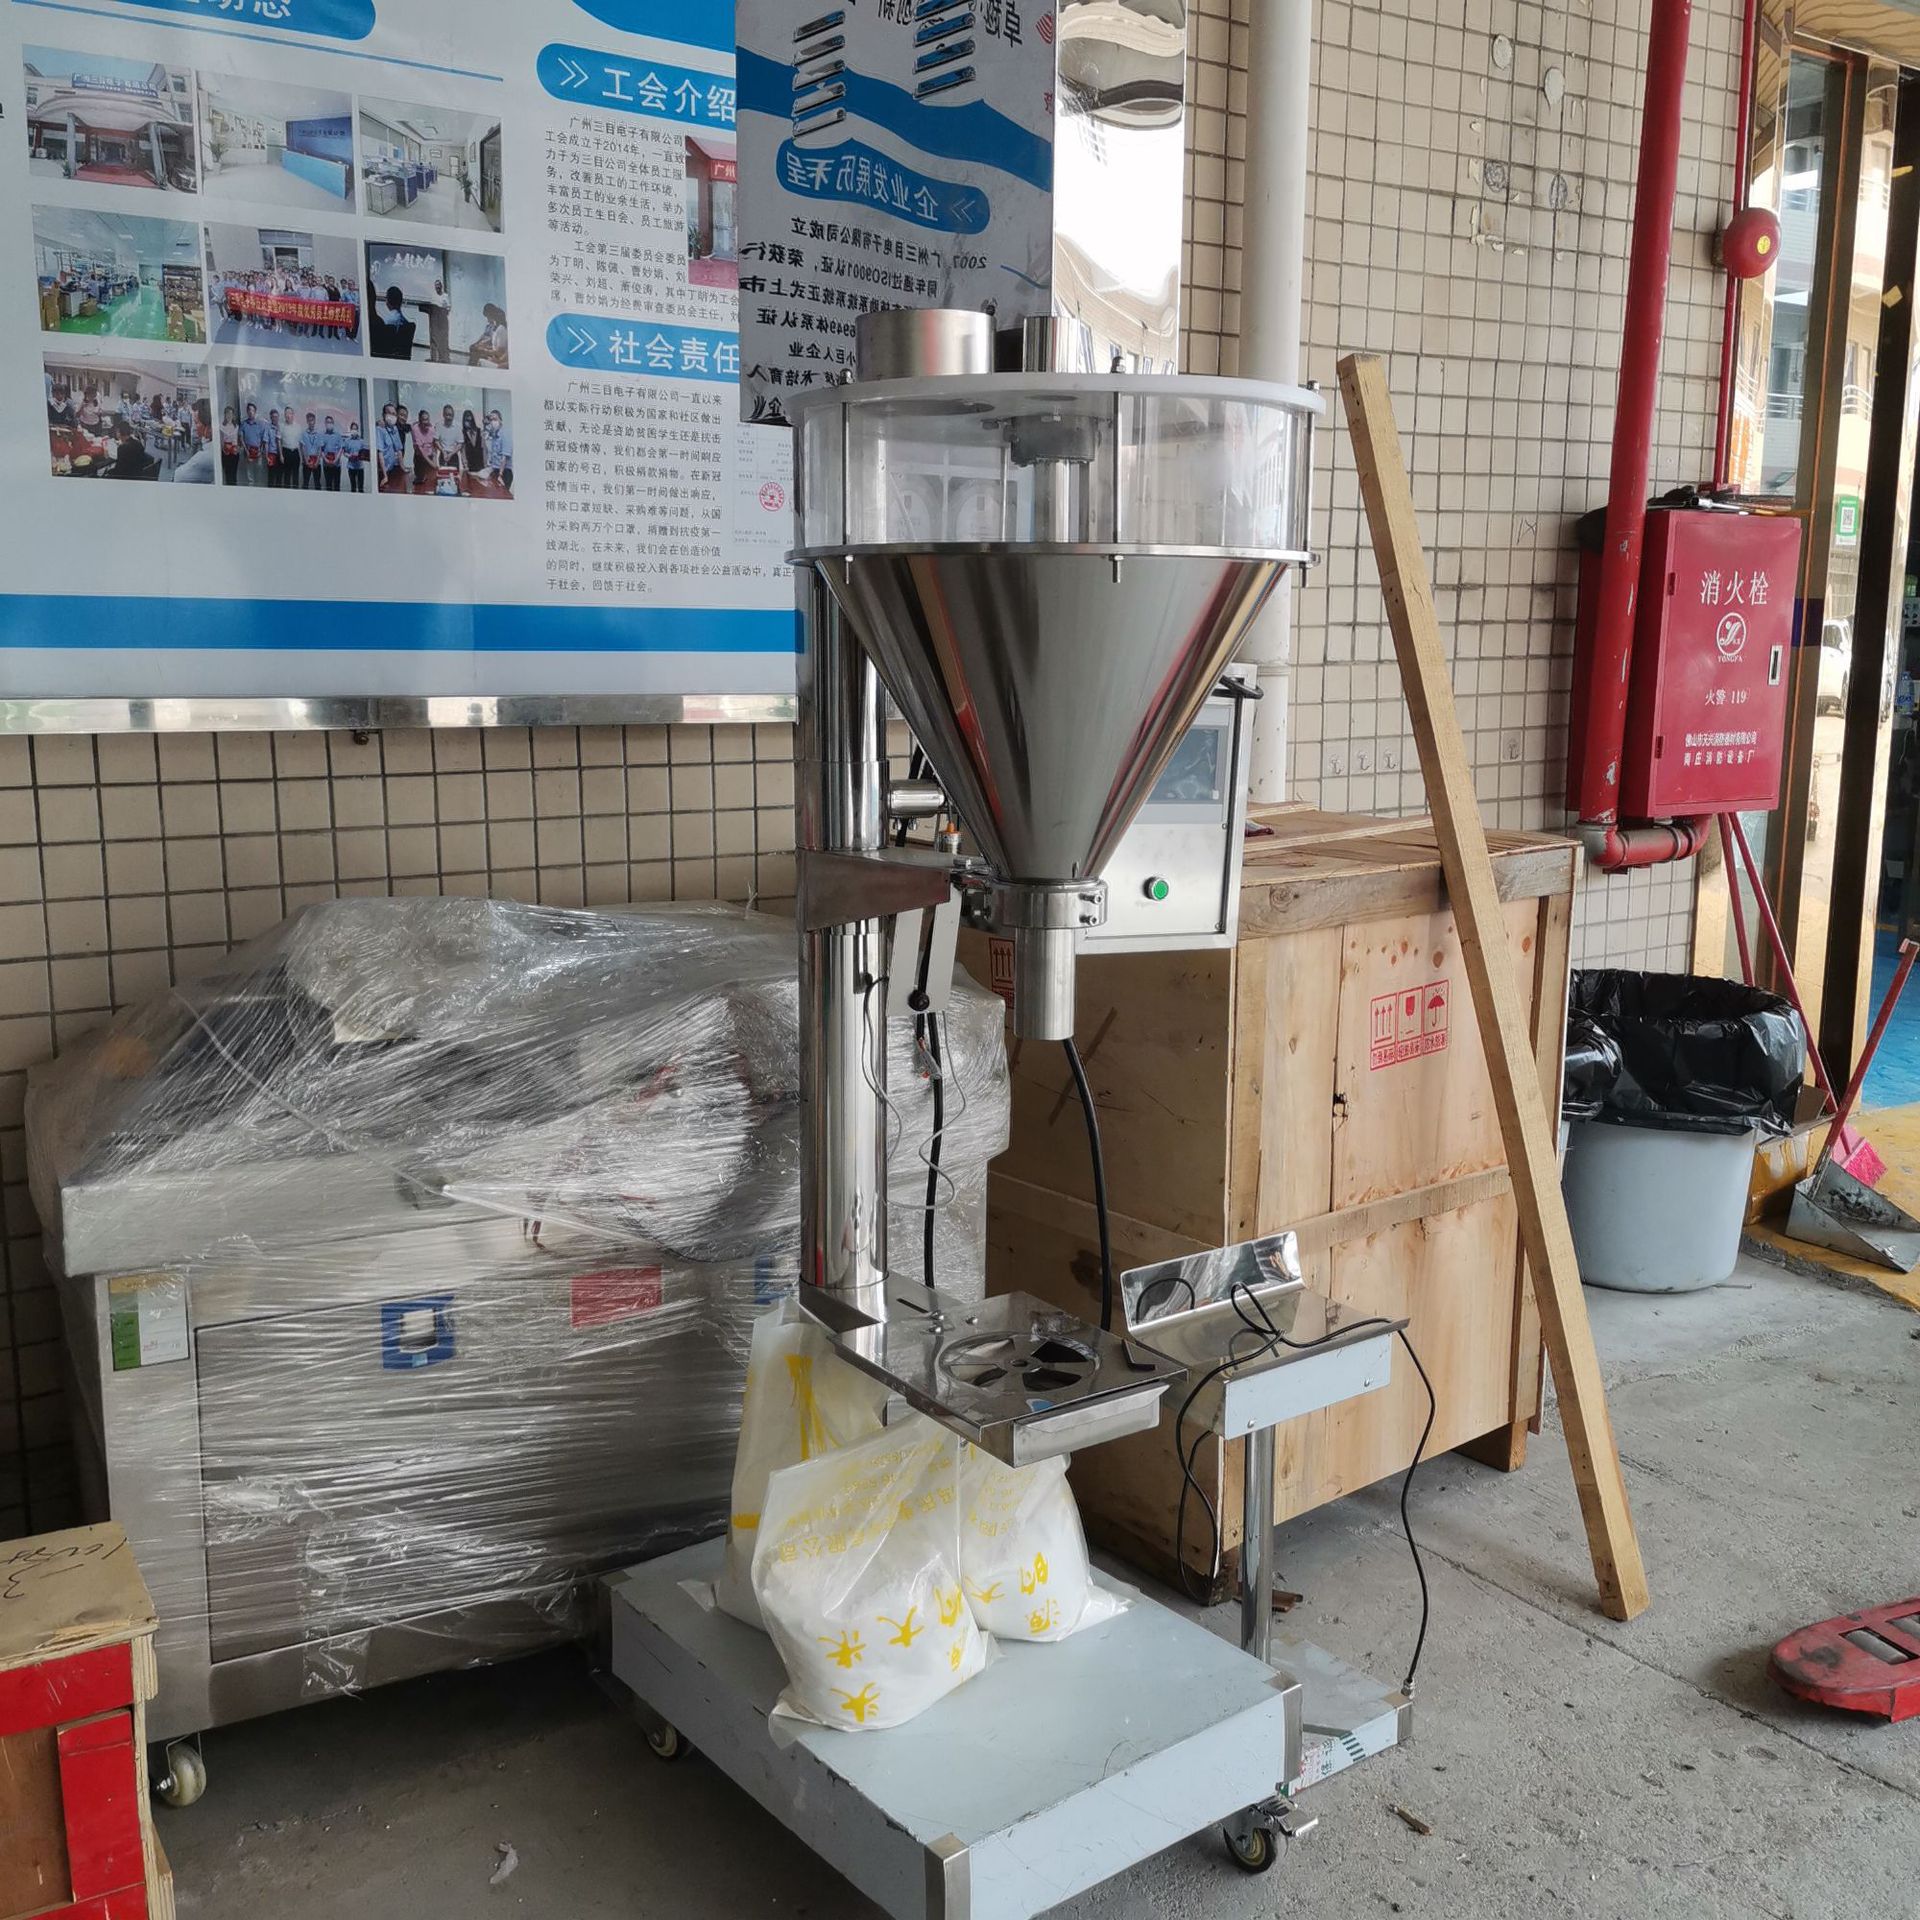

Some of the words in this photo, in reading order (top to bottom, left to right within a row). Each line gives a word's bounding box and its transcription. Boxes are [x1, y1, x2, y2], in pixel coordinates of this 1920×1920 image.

[602, 67, 736, 122] 工会介绍
[570, 117, 683, 147] 广州三目电子有限公司
[609, 330, 740, 374] 社会责任
[568, 381, 722, 405] 广州三目电子有限公司一直以来
[1700, 570, 1769, 605] 消火栓
[1705, 689, 1726, 706] 火警
[1731, 689, 1747, 704] 119
